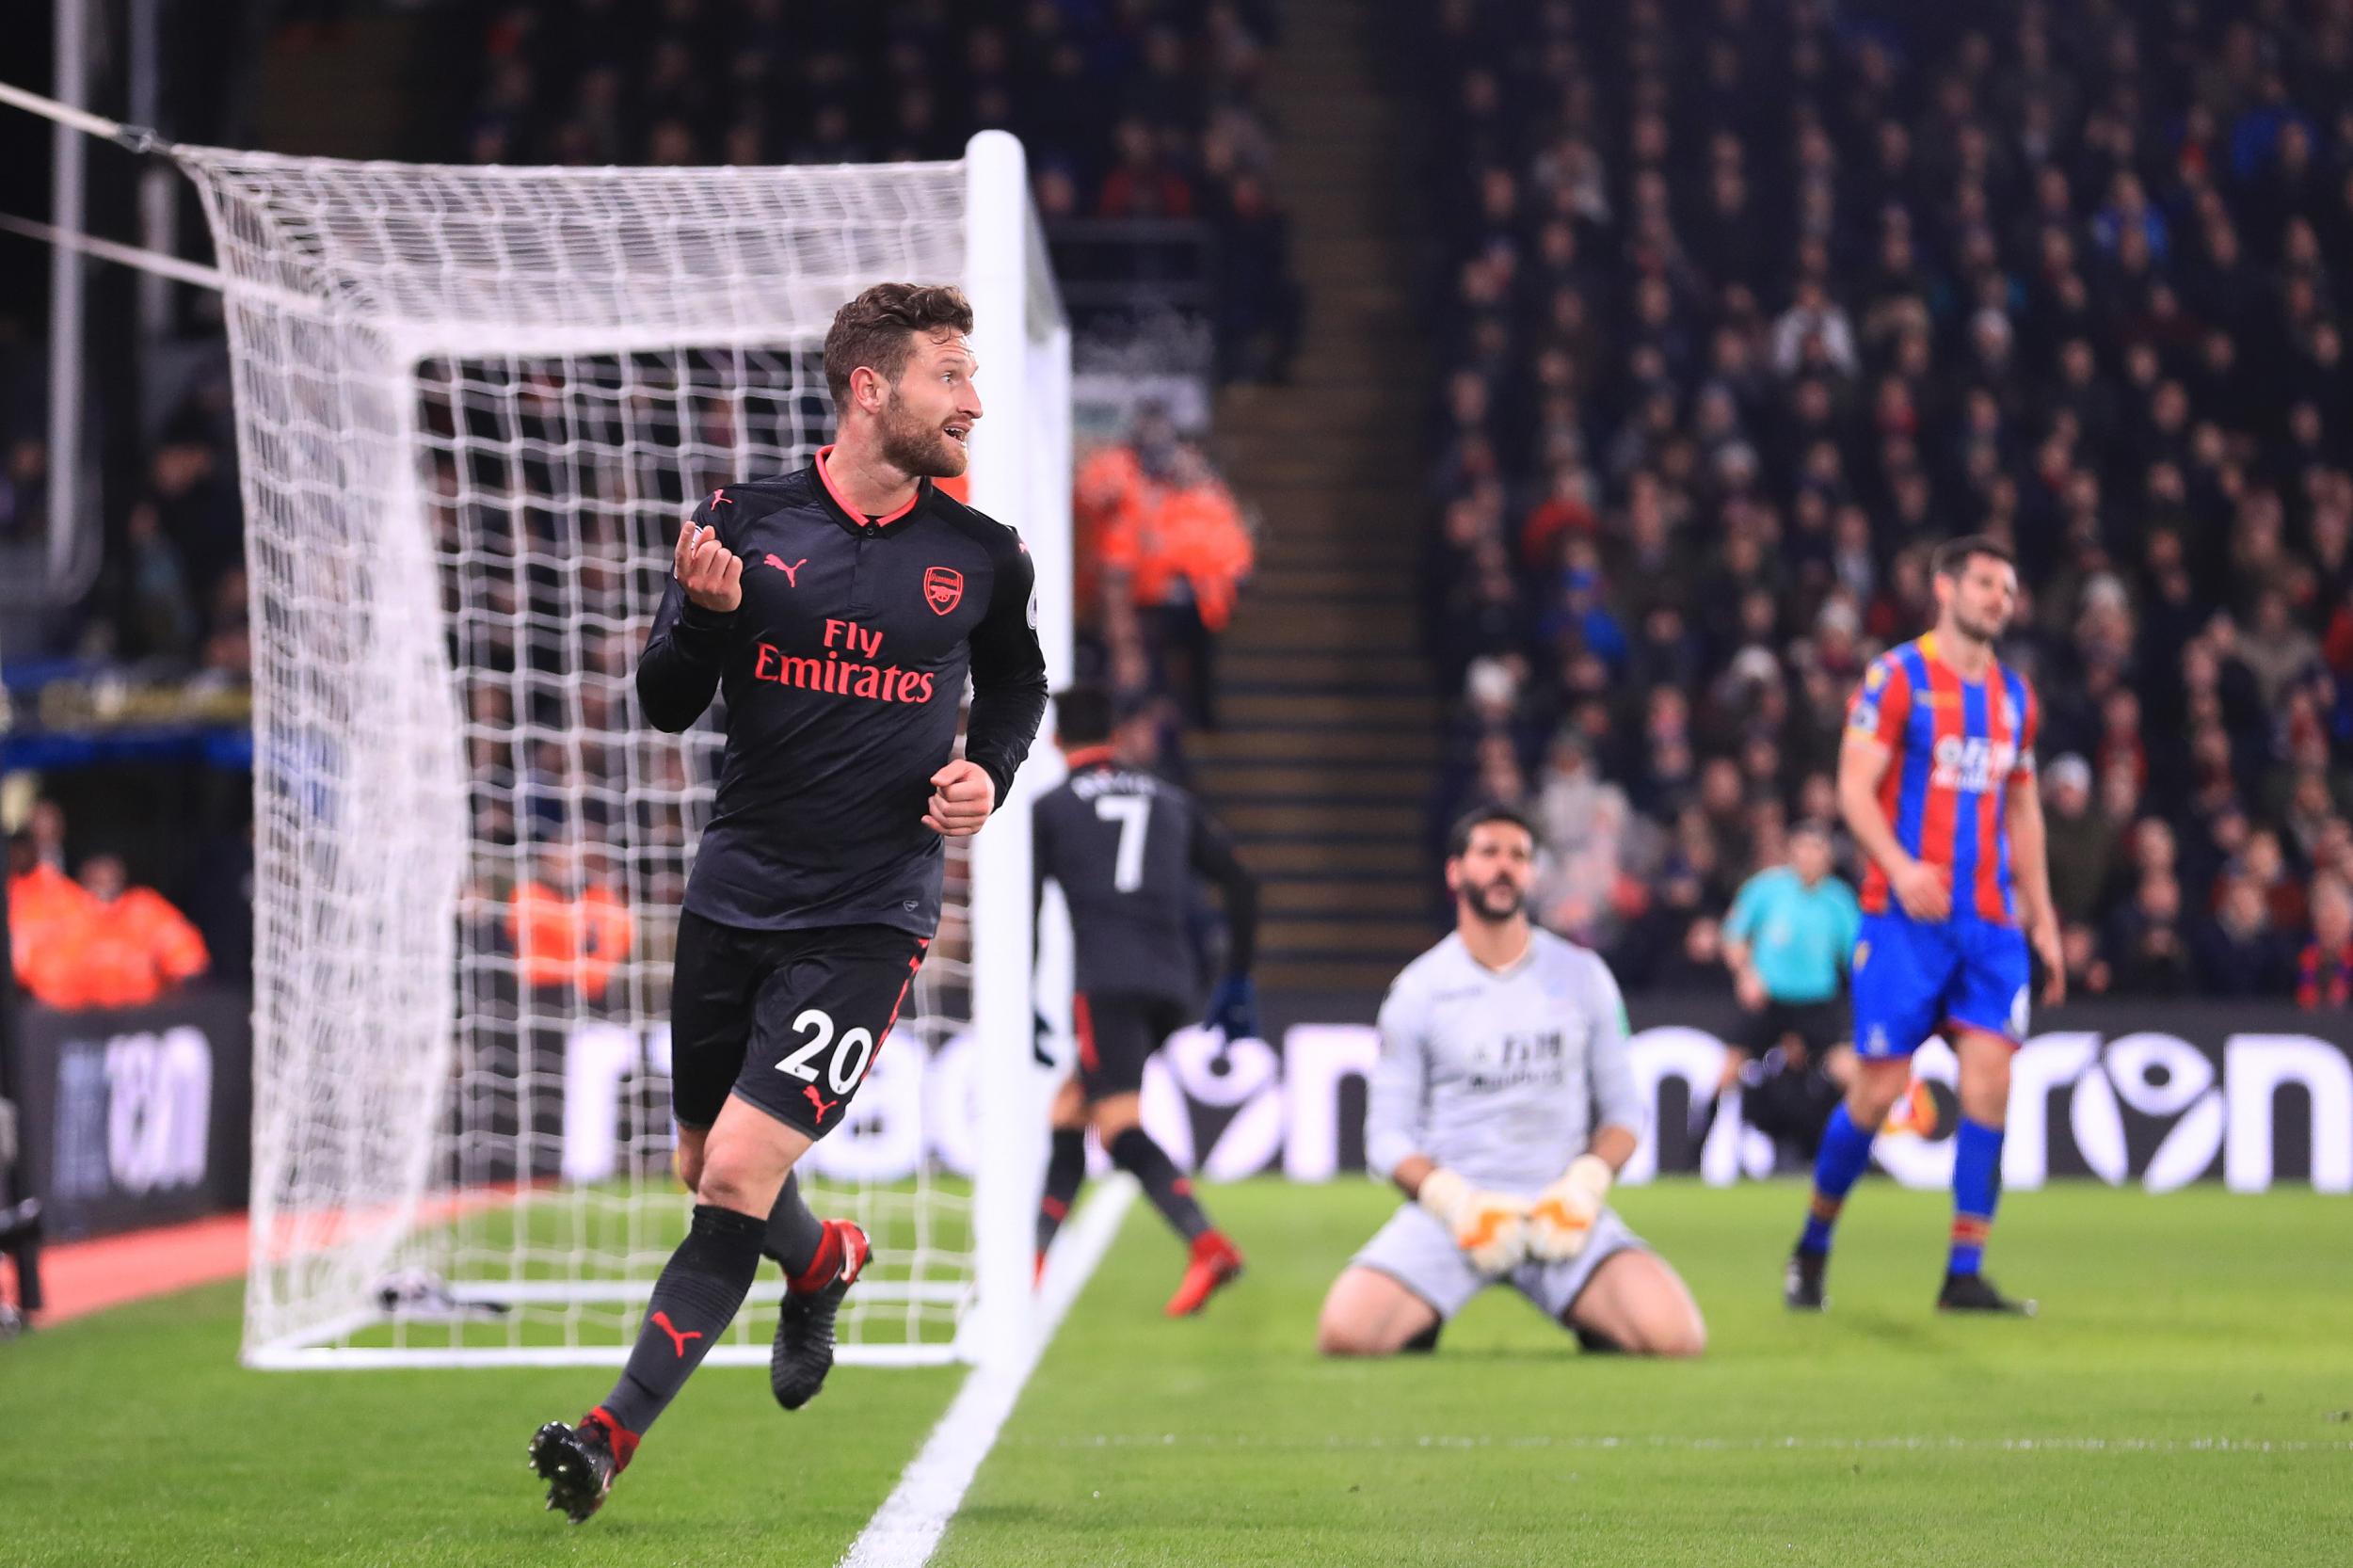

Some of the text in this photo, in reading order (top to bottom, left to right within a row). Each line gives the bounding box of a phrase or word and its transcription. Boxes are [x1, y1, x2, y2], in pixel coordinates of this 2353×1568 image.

[755, 642, 935, 704] Emirates
[823, 618, 884, 659] Fly
[1095, 796, 1151, 892] 7
[775, 1009, 873, 1096] 20
